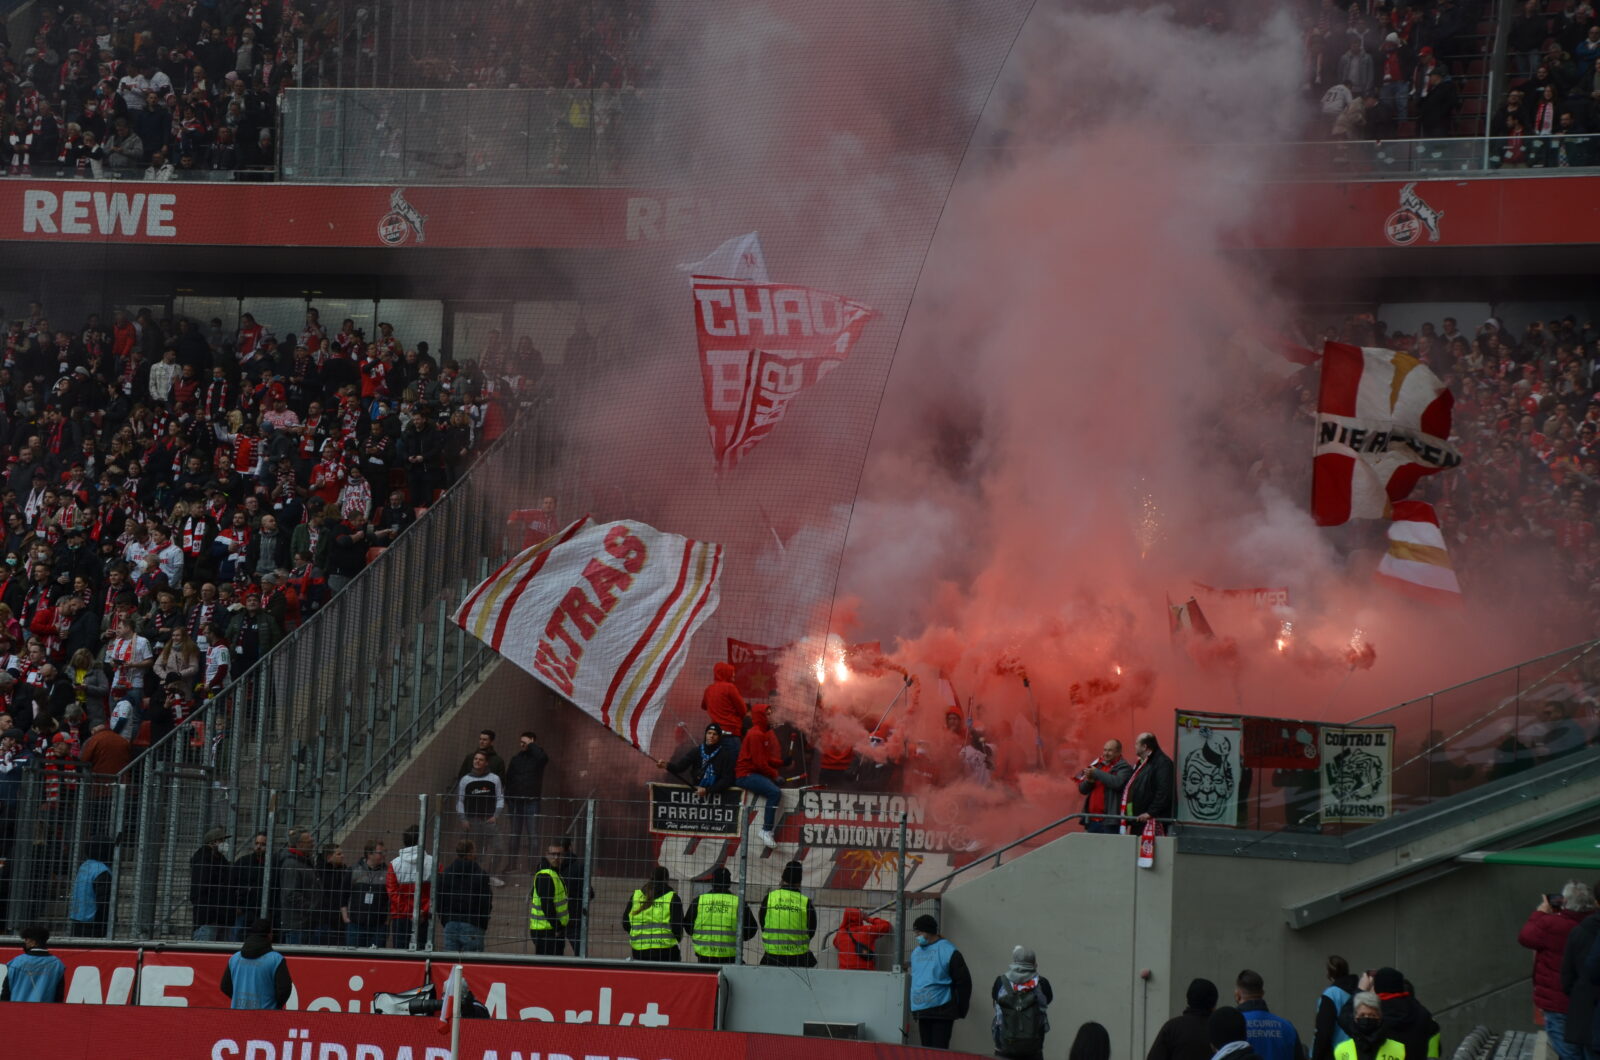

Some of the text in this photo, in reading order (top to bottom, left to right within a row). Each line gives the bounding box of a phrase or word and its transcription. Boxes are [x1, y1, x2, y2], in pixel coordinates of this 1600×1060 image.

[23, 190, 177, 237] REWE
[1325, 733, 1387, 747] CONTRO IL
[670, 791, 721, 805] CURVA
[658, 805, 734, 822] PARADISO
[803, 791, 926, 825] SEKTION
[803, 823, 949, 850] STADIONVERBOT
[1246, 1019, 1283, 1030] ECURITY
[1246, 1029, 1283, 1039] SERVICE
